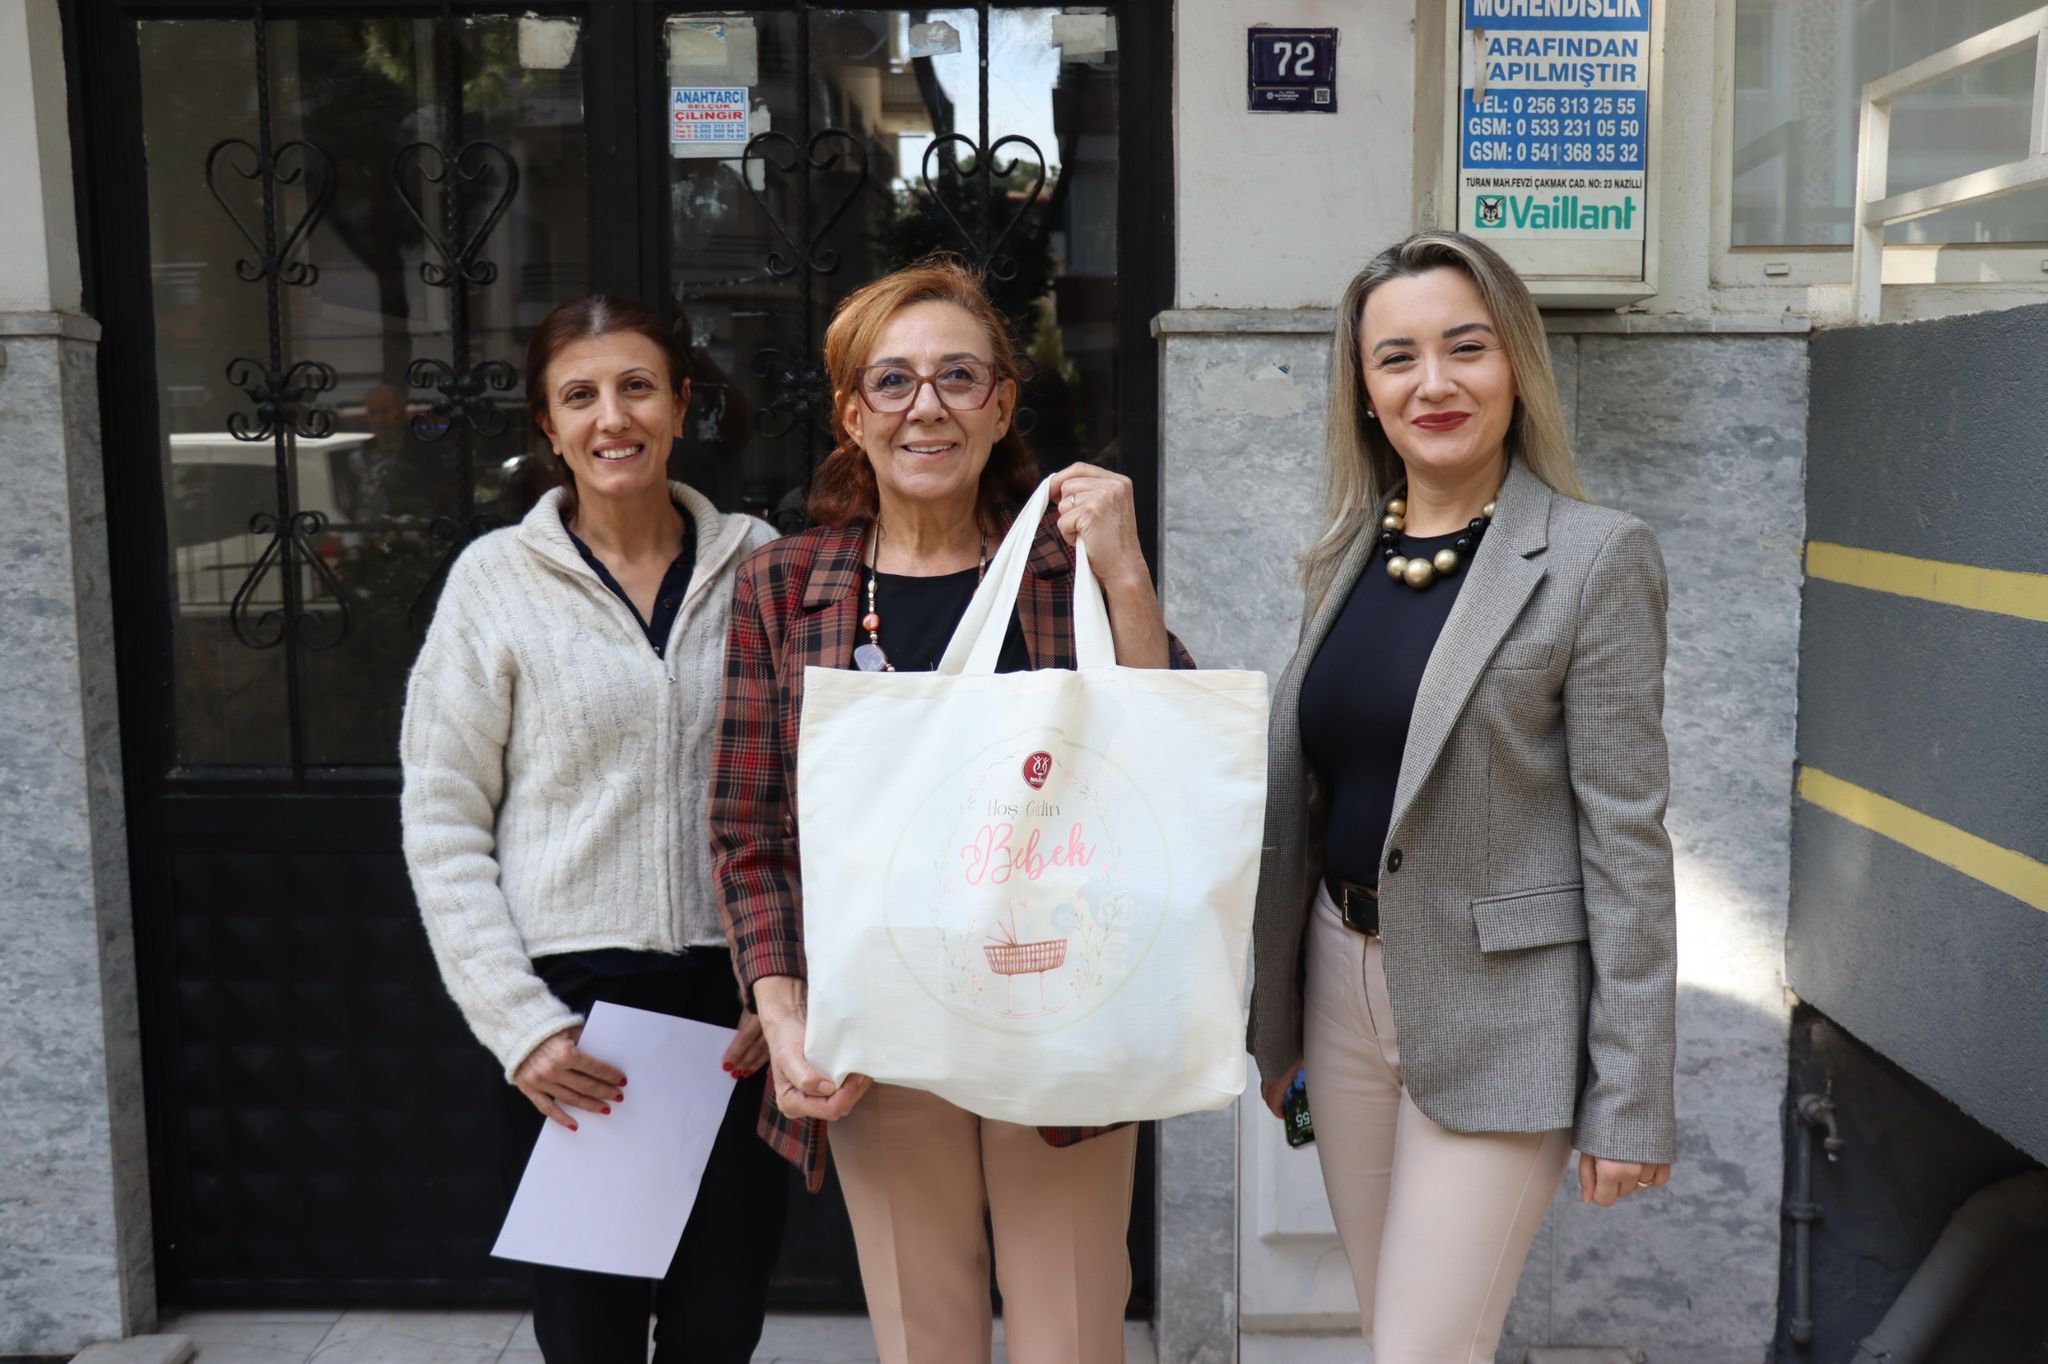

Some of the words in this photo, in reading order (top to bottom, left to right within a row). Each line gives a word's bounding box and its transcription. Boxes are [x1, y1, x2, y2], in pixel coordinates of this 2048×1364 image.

[1474, 37, 1639, 57] ARAFINDAN
[1273, 41, 1315, 76] 72
[1474, 62, 1637, 87] APILMIŞTIR
[675, 91, 744, 103] ANAHTARCI
[1513, 97, 1523, 114] 0
[1527, 97, 1556, 114] 256
[1560, 97, 1589, 114] 313
[1593, 98, 1613, 114] 25
[1617, 98, 1636, 115] 55
[1469, 117, 1512, 136] GSM:
[1516, 119, 1526, 136] 0
[1530, 119, 1560, 136] 533
[1563, 119, 1591, 136] 231
[1596, 120, 1616, 137] 05
[1620, 120, 1639, 137] 50
[1469, 141, 1512, 161] GSM:
[1516, 143, 1527, 161] 0
[1530, 143, 1559, 161] 541
[1563, 143, 1592, 162] 368
[1596, 144, 1616, 162] 35
[1619, 144, 1638, 162] 32
[1465, 177, 1492, 187] TURAN
[1534, 178, 1567, 190] ÇAKMAK
[1569, 178, 1587, 188] CAD.
[1588, 179, 1602, 188] NO:
[1603, 179, 1613, 188] 23
[1509, 195, 1637, 230] Vaillant
[987, 799, 1018, 820] Hoş
[960, 822, 1097, 885] Bebek
